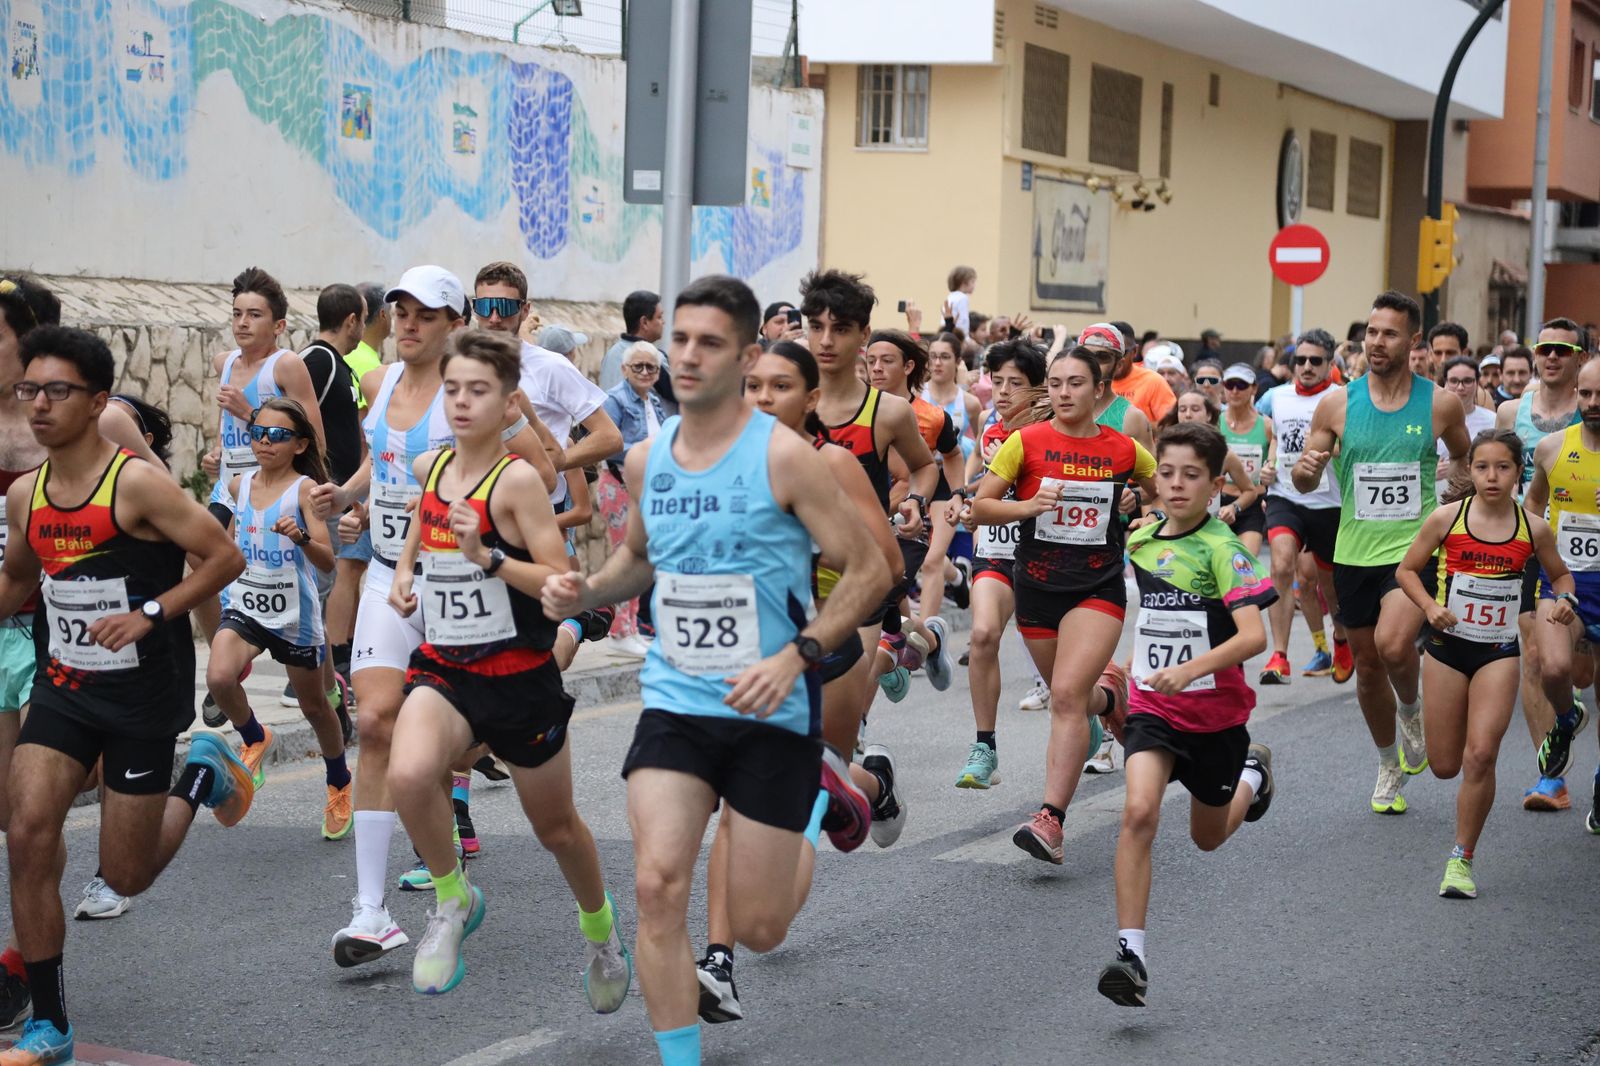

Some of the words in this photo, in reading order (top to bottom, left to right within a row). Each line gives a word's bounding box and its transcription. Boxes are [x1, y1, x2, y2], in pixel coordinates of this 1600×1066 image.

[1045, 449, 1113, 468] Málaga
[1063, 463, 1113, 479] Bahía
[650, 489, 720, 520] nerja
[1367, 485, 1410, 505] 763
[422, 510, 450, 529] Mála
[1052, 506, 1099, 529] 198
[39, 522, 92, 540] Málaga
[430, 528, 456, 543] Bah
[54, 537, 94, 551] Bahía
[1569, 536, 1599, 558] 86
[1461, 550, 1513, 567] Málaga
[242, 591, 287, 614] 680
[434, 588, 492, 620] 751
[1462, 603, 1507, 627] 151
[57, 616, 104, 647] 92
[676, 616, 739, 649] 528
[1148, 643, 1193, 670] 674
